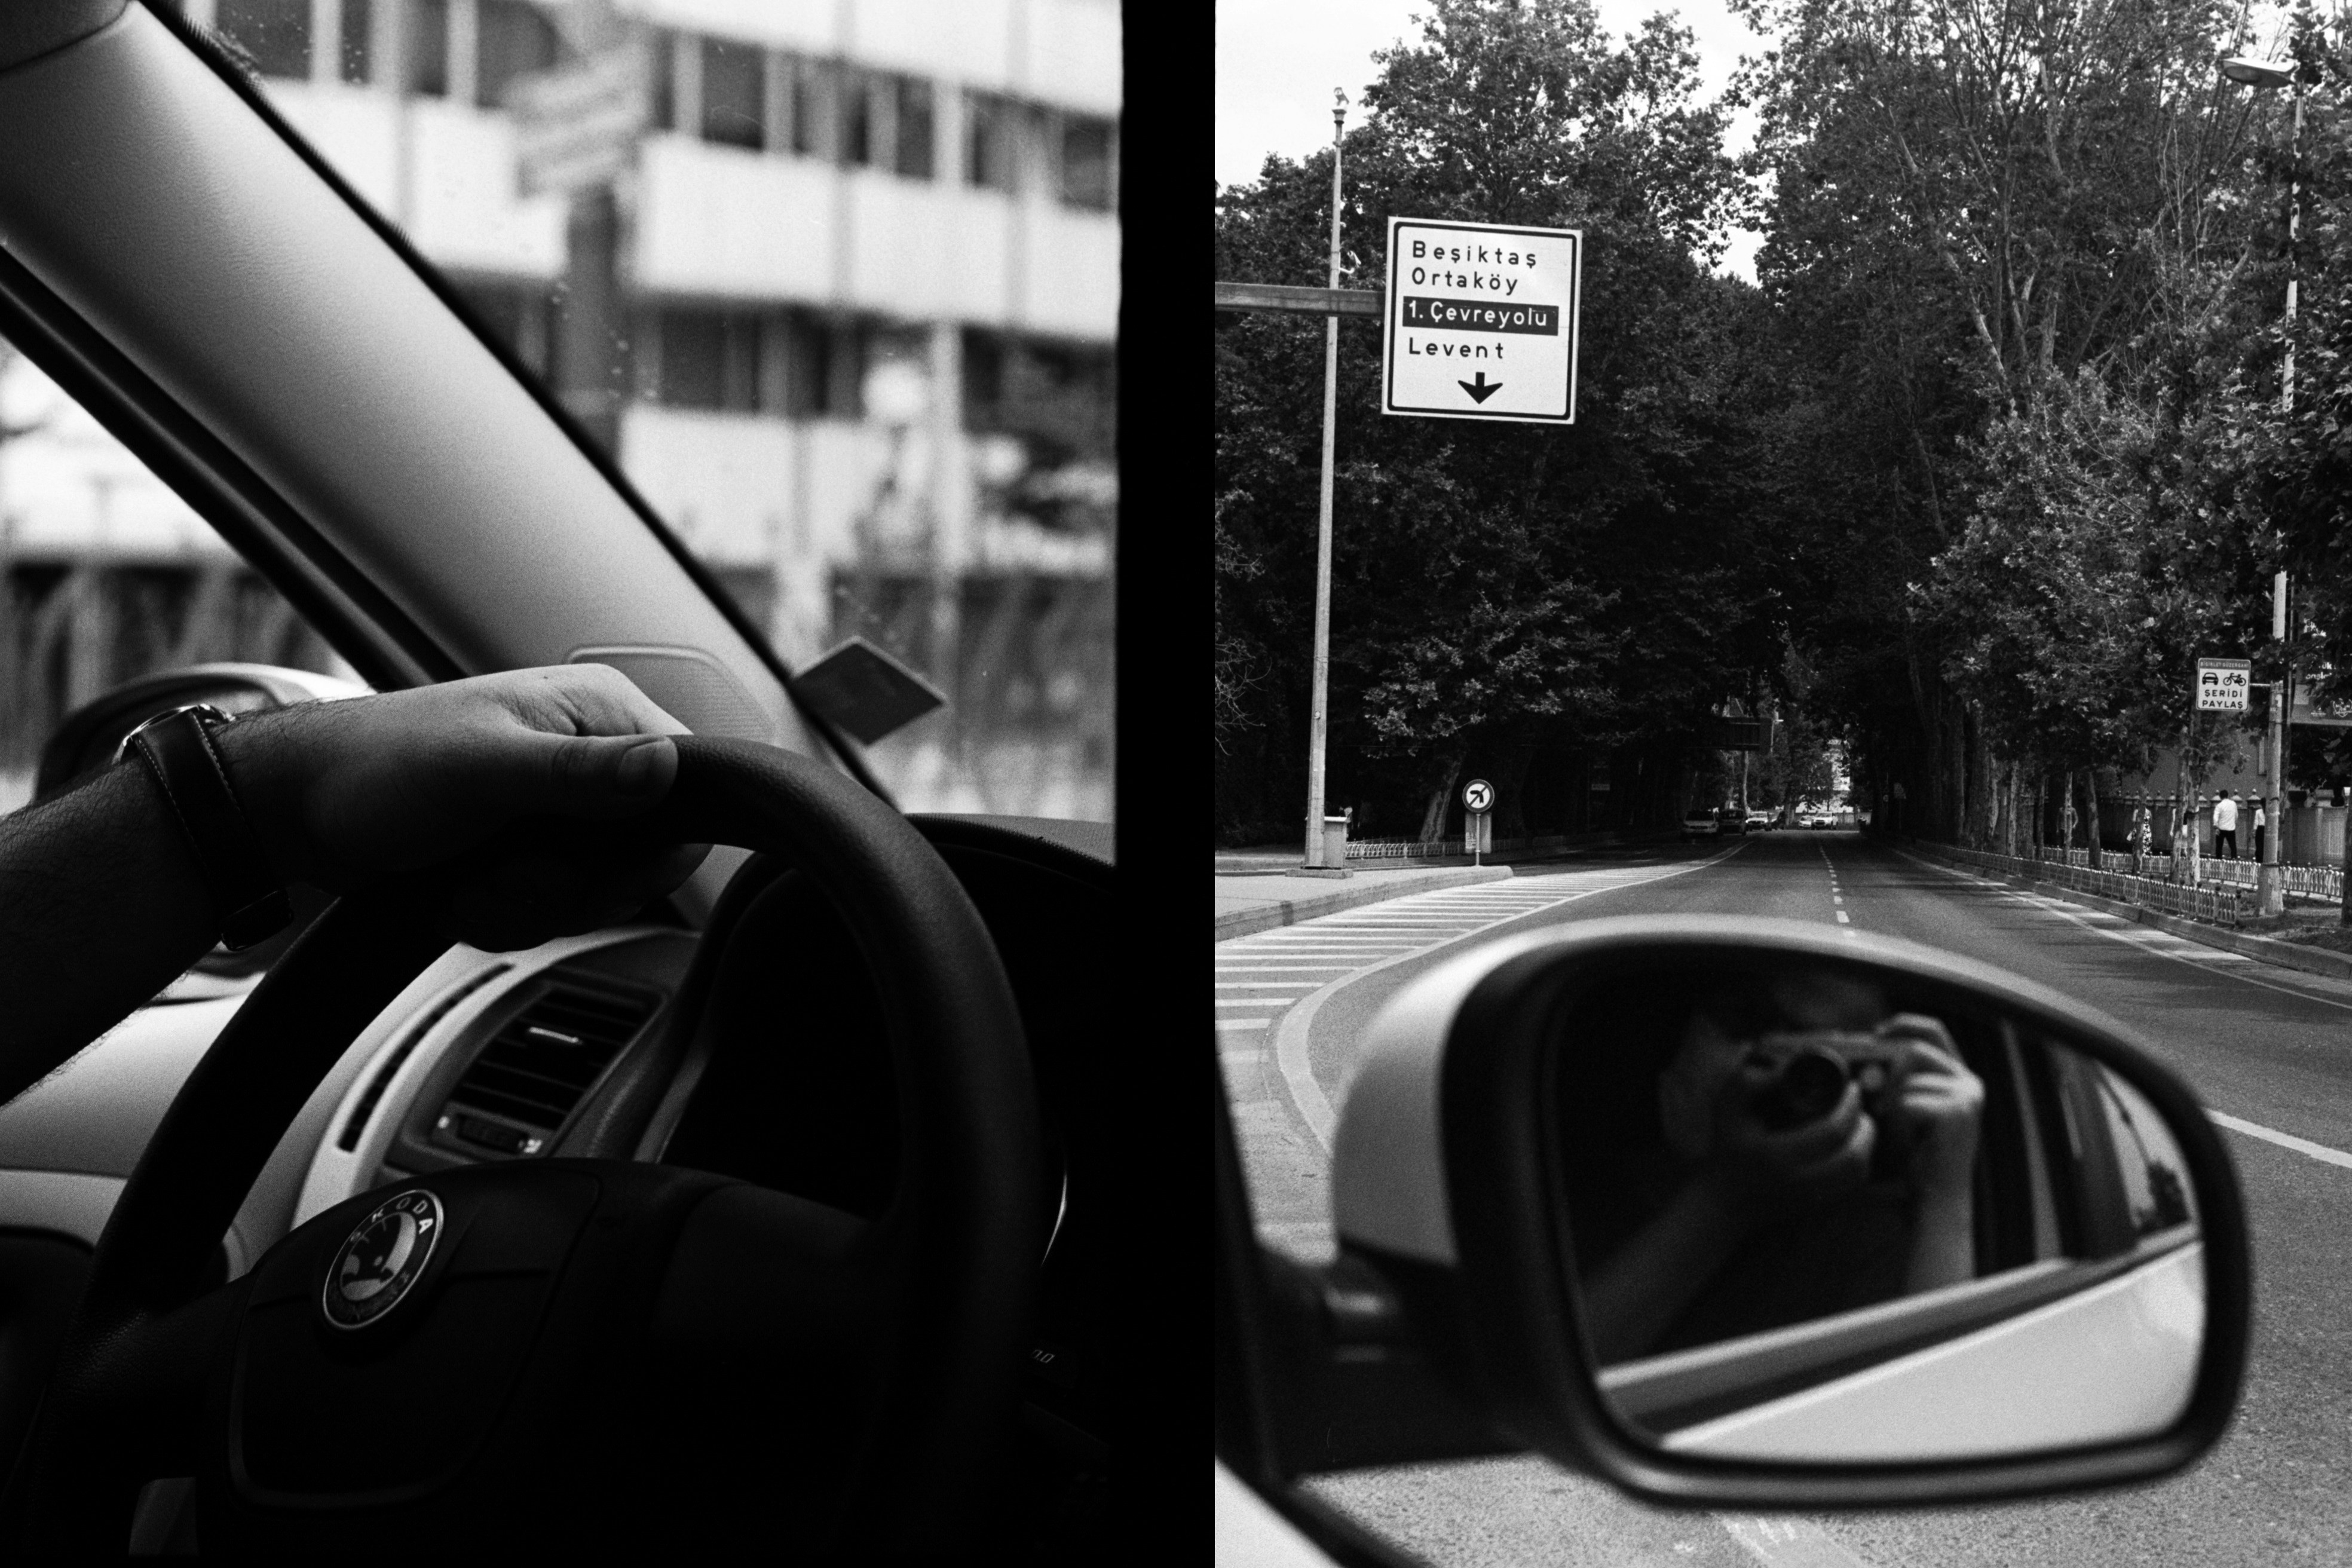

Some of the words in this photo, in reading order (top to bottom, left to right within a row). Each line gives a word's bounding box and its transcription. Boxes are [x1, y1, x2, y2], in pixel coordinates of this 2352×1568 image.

[1412, 240, 1536, 269] Beşiktaş
[1411, 267, 1518, 296] Ortaköy
[1408, 300, 1423, 318] 1.
[1430, 301, 1547, 329] Çevreyolu
[1408, 337, 1503, 359] Levent
[2202, 700, 2243, 709] PAYLAŞ
[2204, 688, 2242, 697] ŞERİDİ
